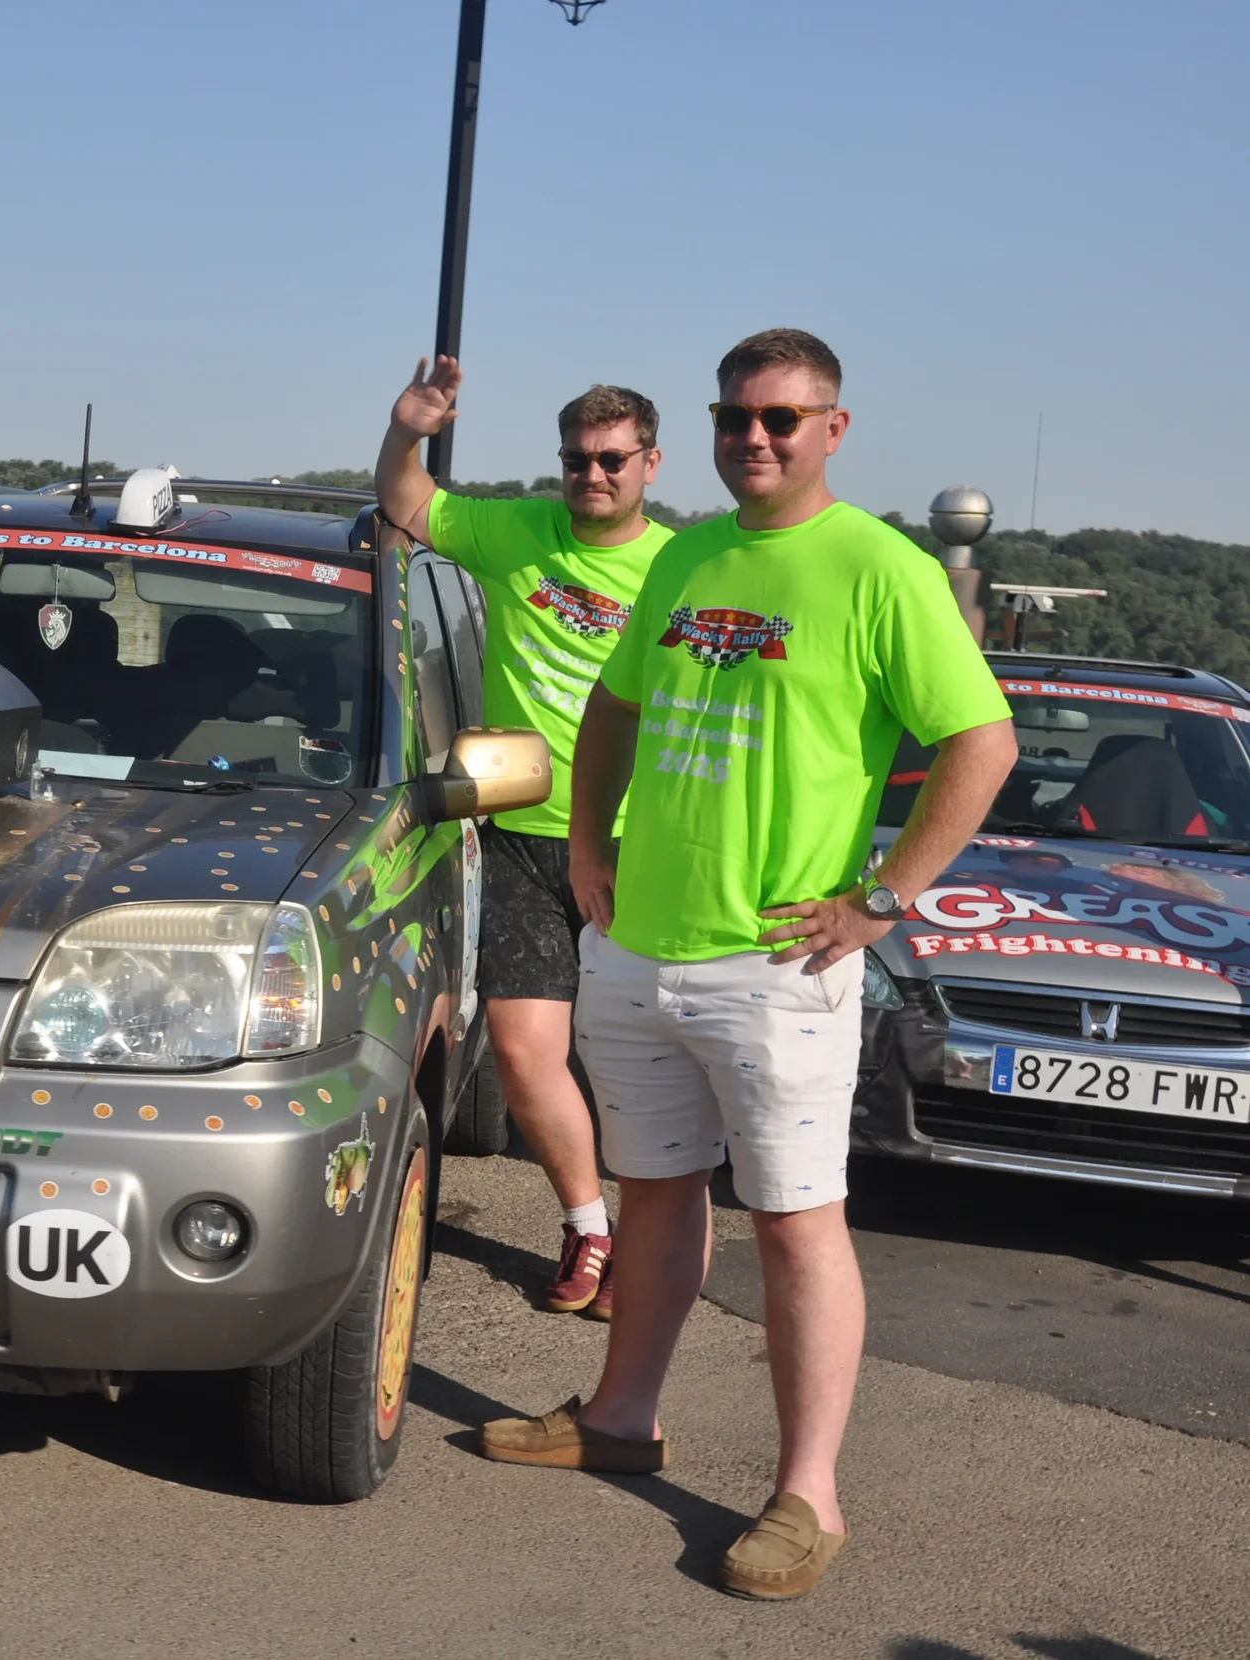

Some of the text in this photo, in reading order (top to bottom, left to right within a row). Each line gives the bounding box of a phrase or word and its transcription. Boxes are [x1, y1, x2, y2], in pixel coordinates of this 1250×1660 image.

[152, 483, 173, 520] PIZZA
[18, 533, 52, 547] to
[61, 535, 229, 564] Barcelona
[550, 591, 626, 627] Wacky Rally
[680, 623, 771, 646] Wacky Rally
[651, 689, 764, 722] Brooklands
[1006, 682, 1033, 693] to
[1040, 683, 1170, 706] Barcelona
[643, 718, 764, 751] to Barcelona
[656, 748, 733, 784] 2025
[997, 1055, 1239, 1115] E 8728 FWR
[18, 1225, 112, 1286] UK
